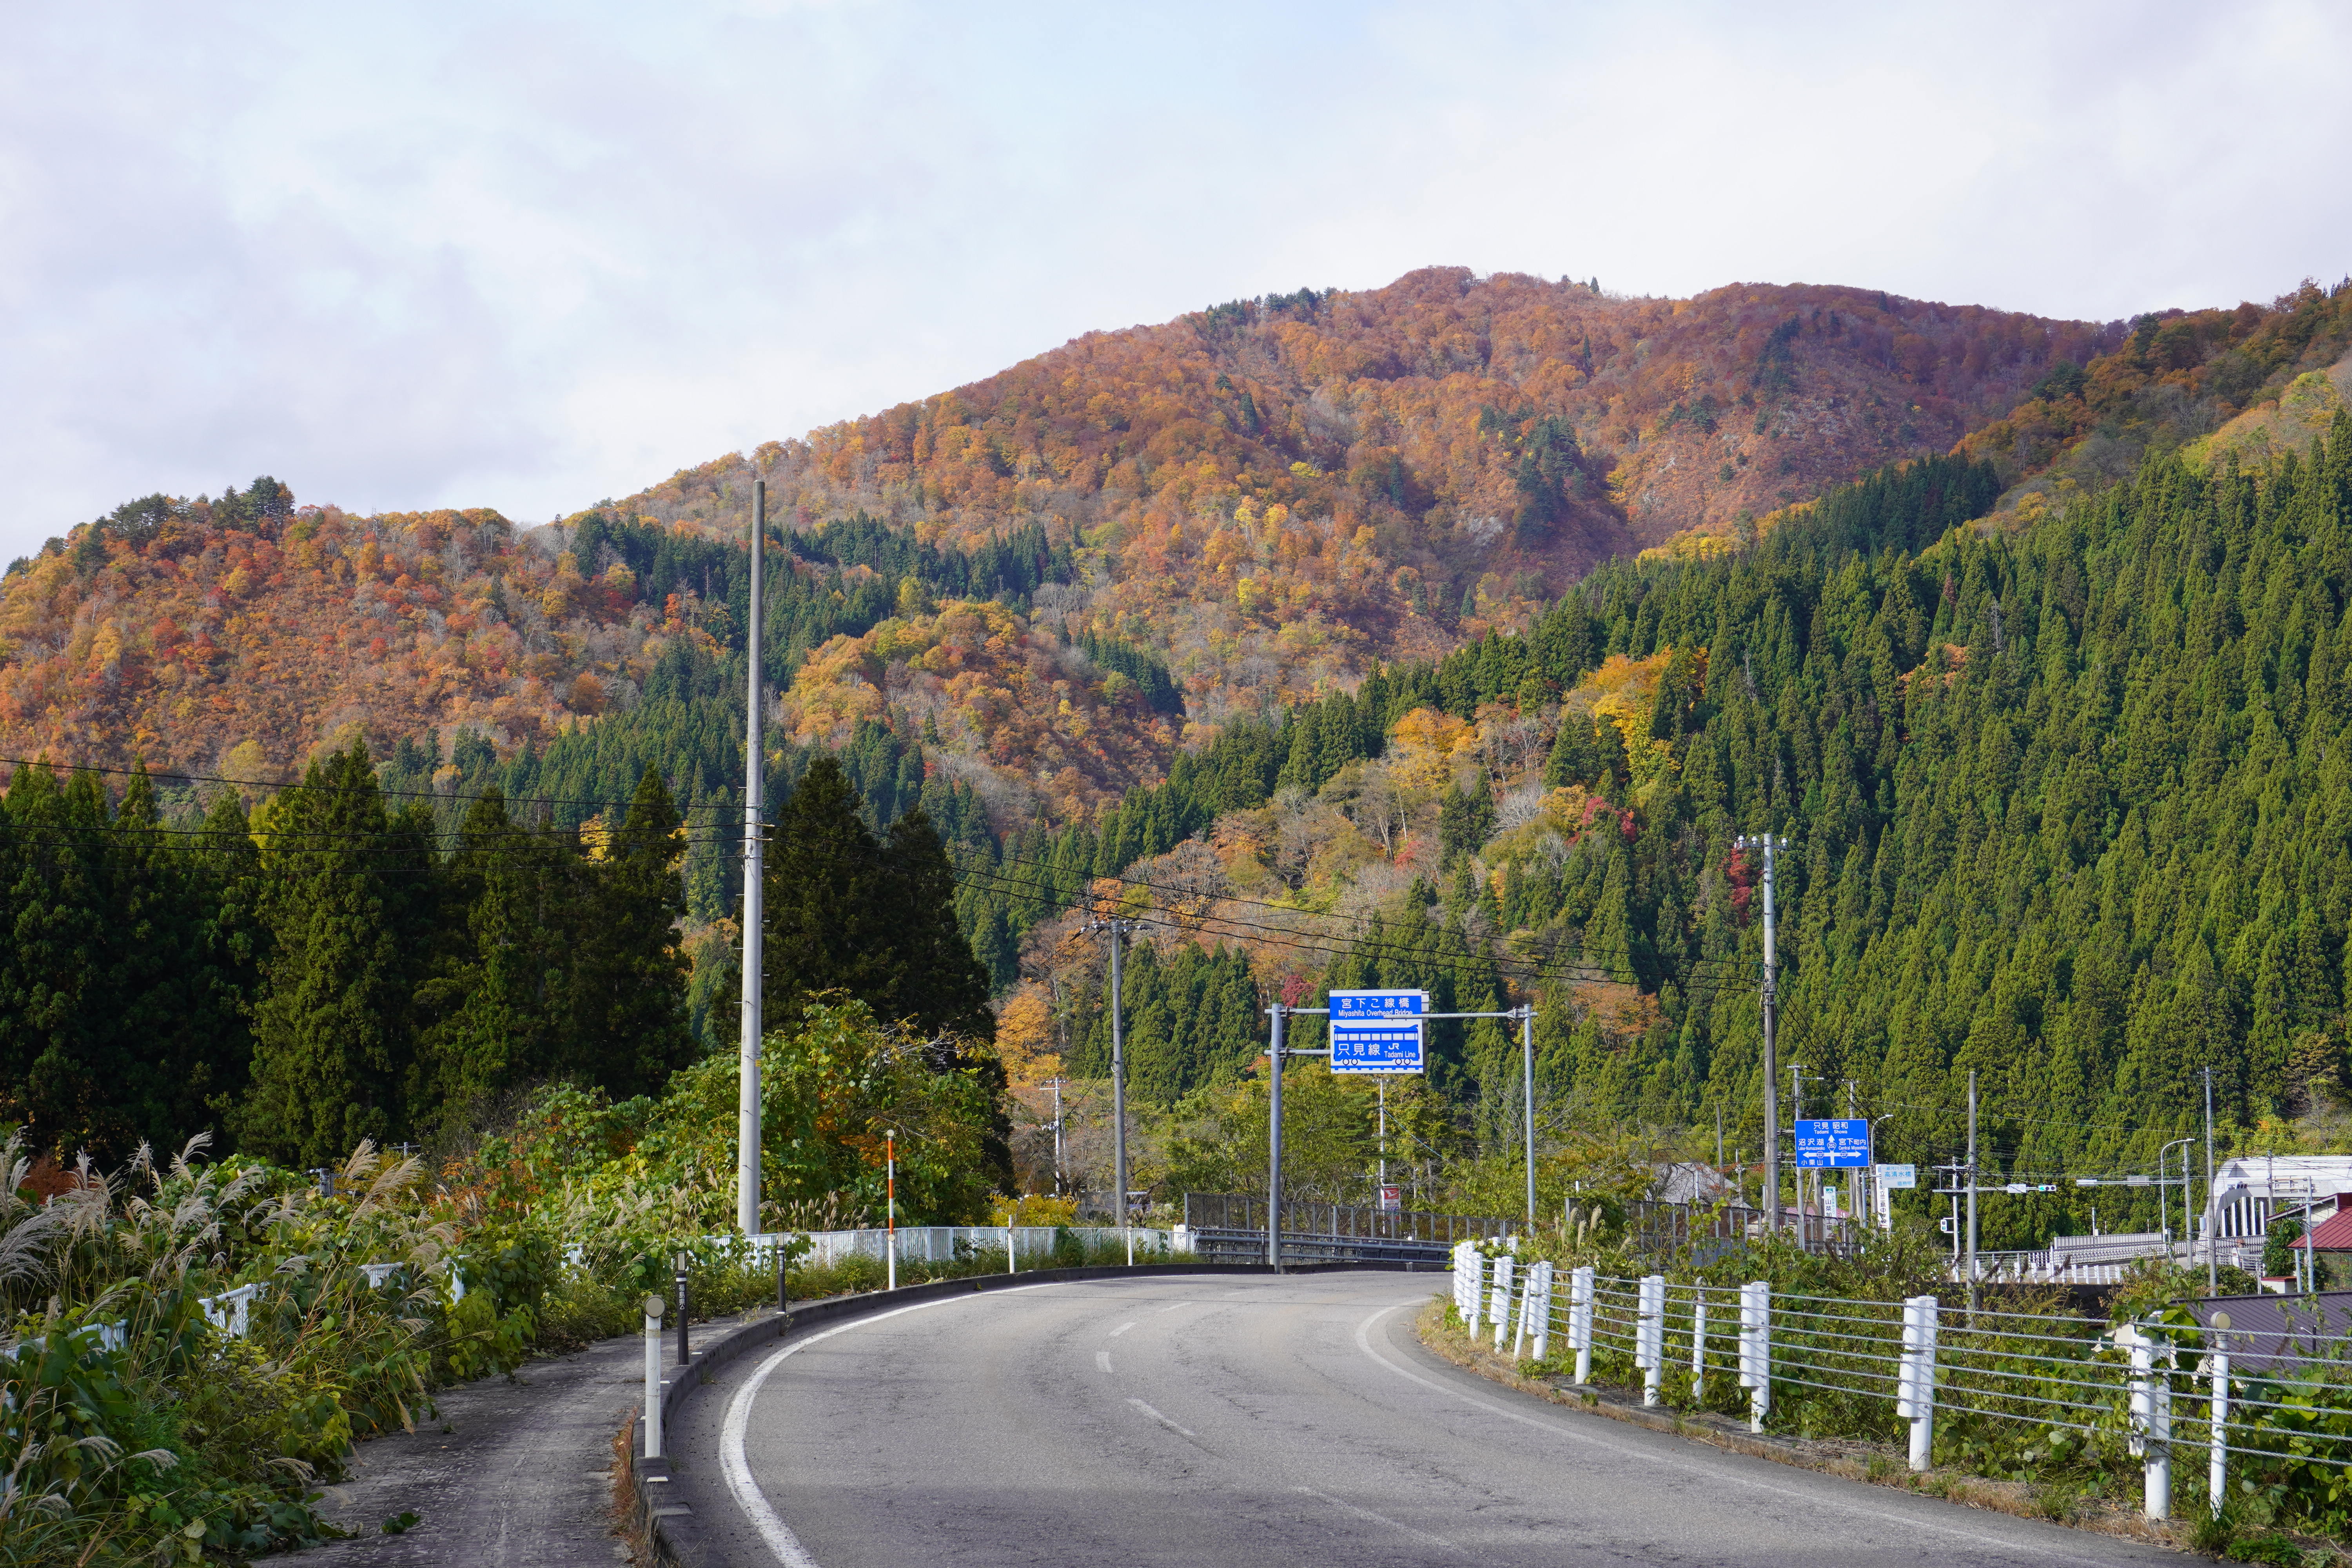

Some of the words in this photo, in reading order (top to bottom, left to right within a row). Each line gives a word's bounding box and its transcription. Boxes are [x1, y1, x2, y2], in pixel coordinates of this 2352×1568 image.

[1341, 997, 1410, 1009] 宮下こ線橋
[1338, 1009, 1365, 1018] Miyashita
[1338, 1043, 1381, 1056] 只見線
